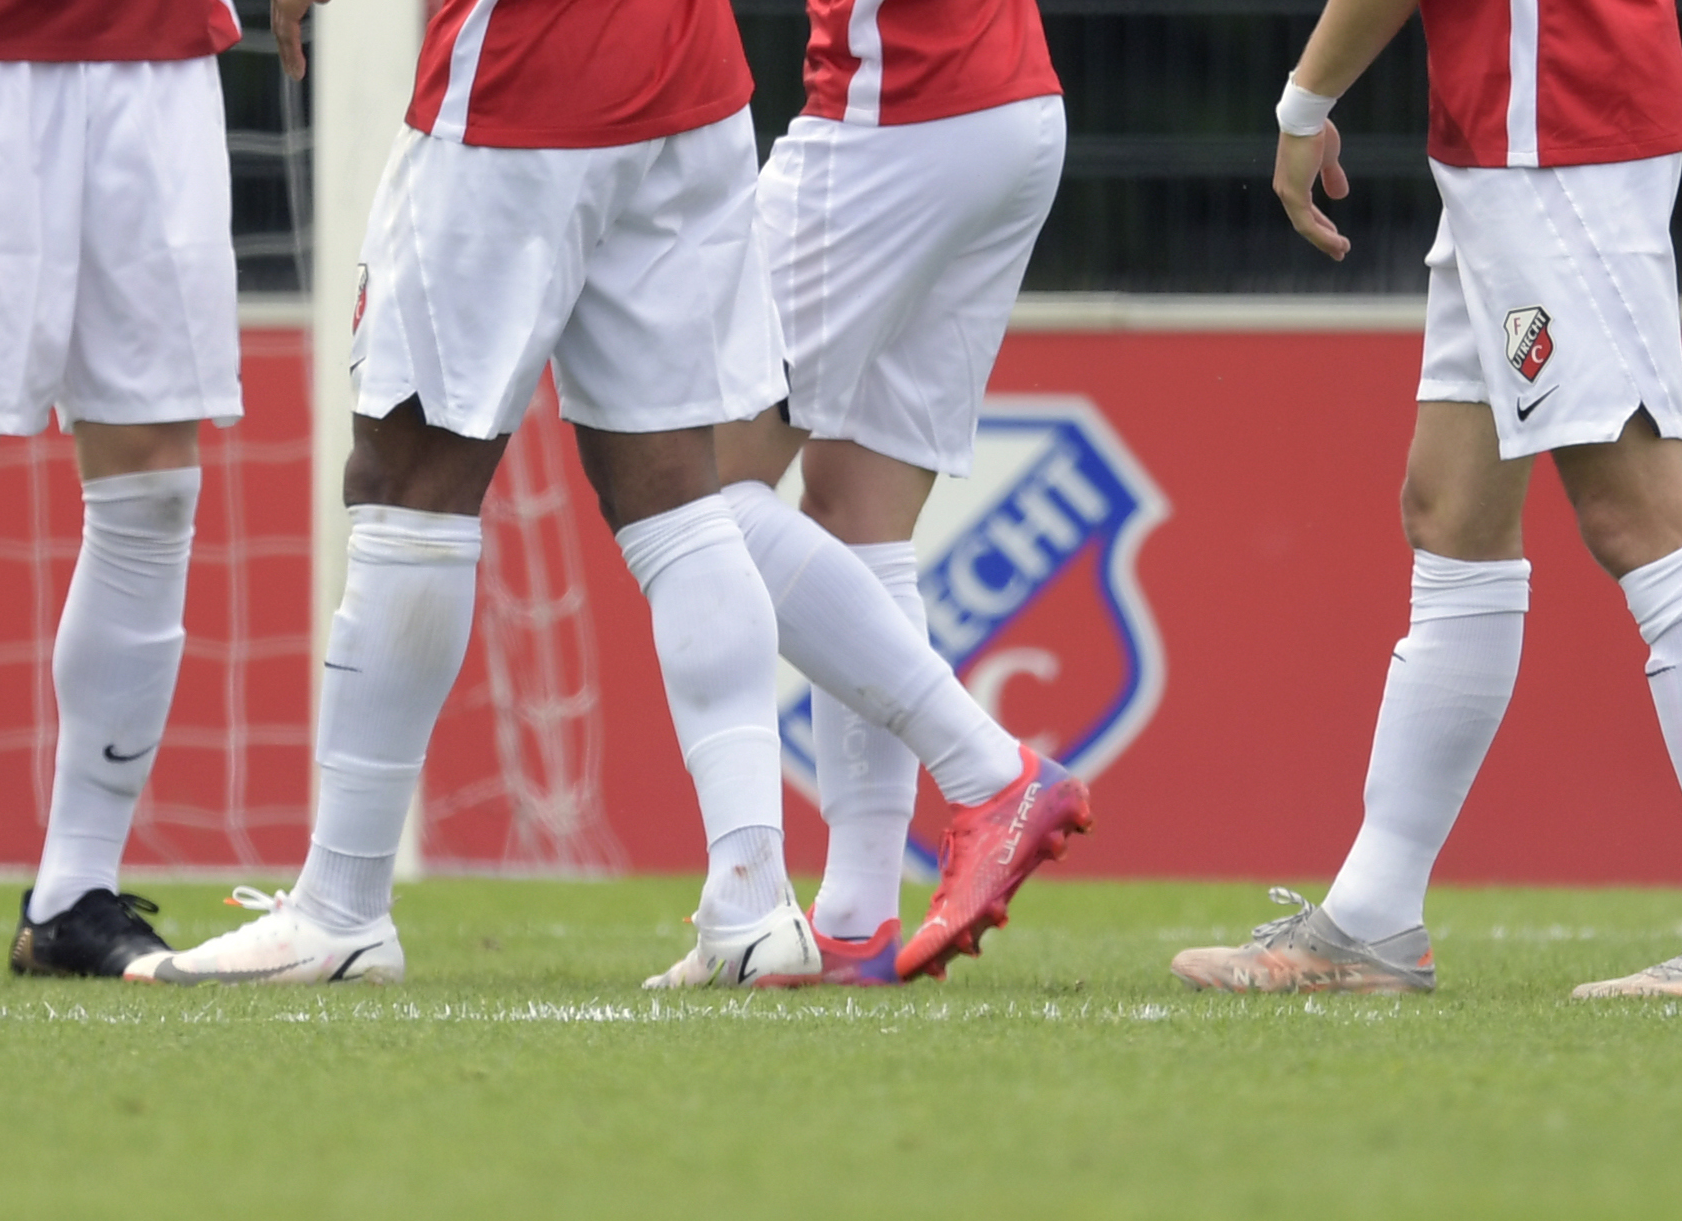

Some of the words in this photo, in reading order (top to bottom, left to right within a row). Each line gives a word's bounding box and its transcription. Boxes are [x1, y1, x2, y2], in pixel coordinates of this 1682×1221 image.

[1511, 311, 1547, 370] UTRECHT
[917, 455, 1108, 653] ECHT
[997, 781, 1042, 866] ULTRA
